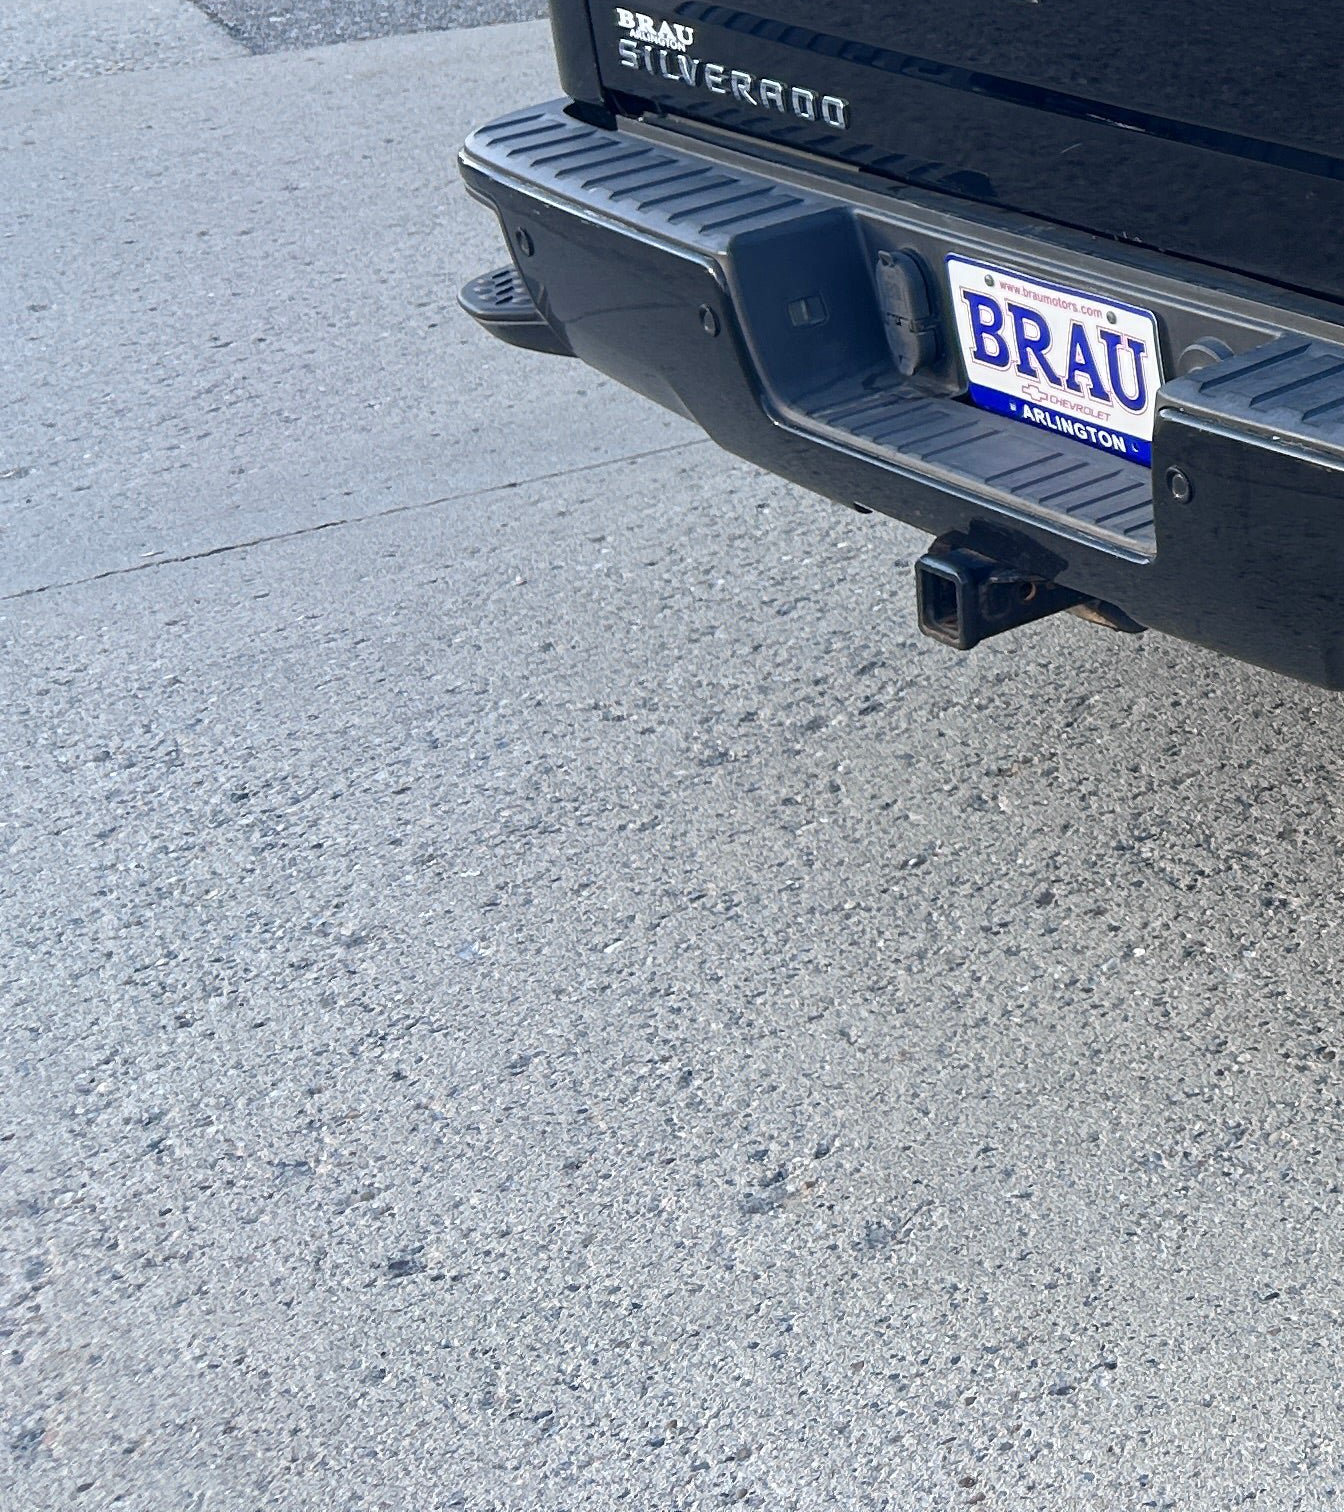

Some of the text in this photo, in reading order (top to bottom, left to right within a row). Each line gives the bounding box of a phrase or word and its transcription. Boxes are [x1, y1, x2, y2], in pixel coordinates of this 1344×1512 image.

[616, 7, 694, 46] BRAU
[629, 29, 686, 53] ARLINGTON
[618, 38, 850, 130] SILVERADO
[999, 280, 1104, 319] www.braumotors.com
[960, 288, 1148, 415] BRAU
[1022, 403, 1127, 453] ARLINGTON
[1049, 394, 1112, 423] CHEVROLET
